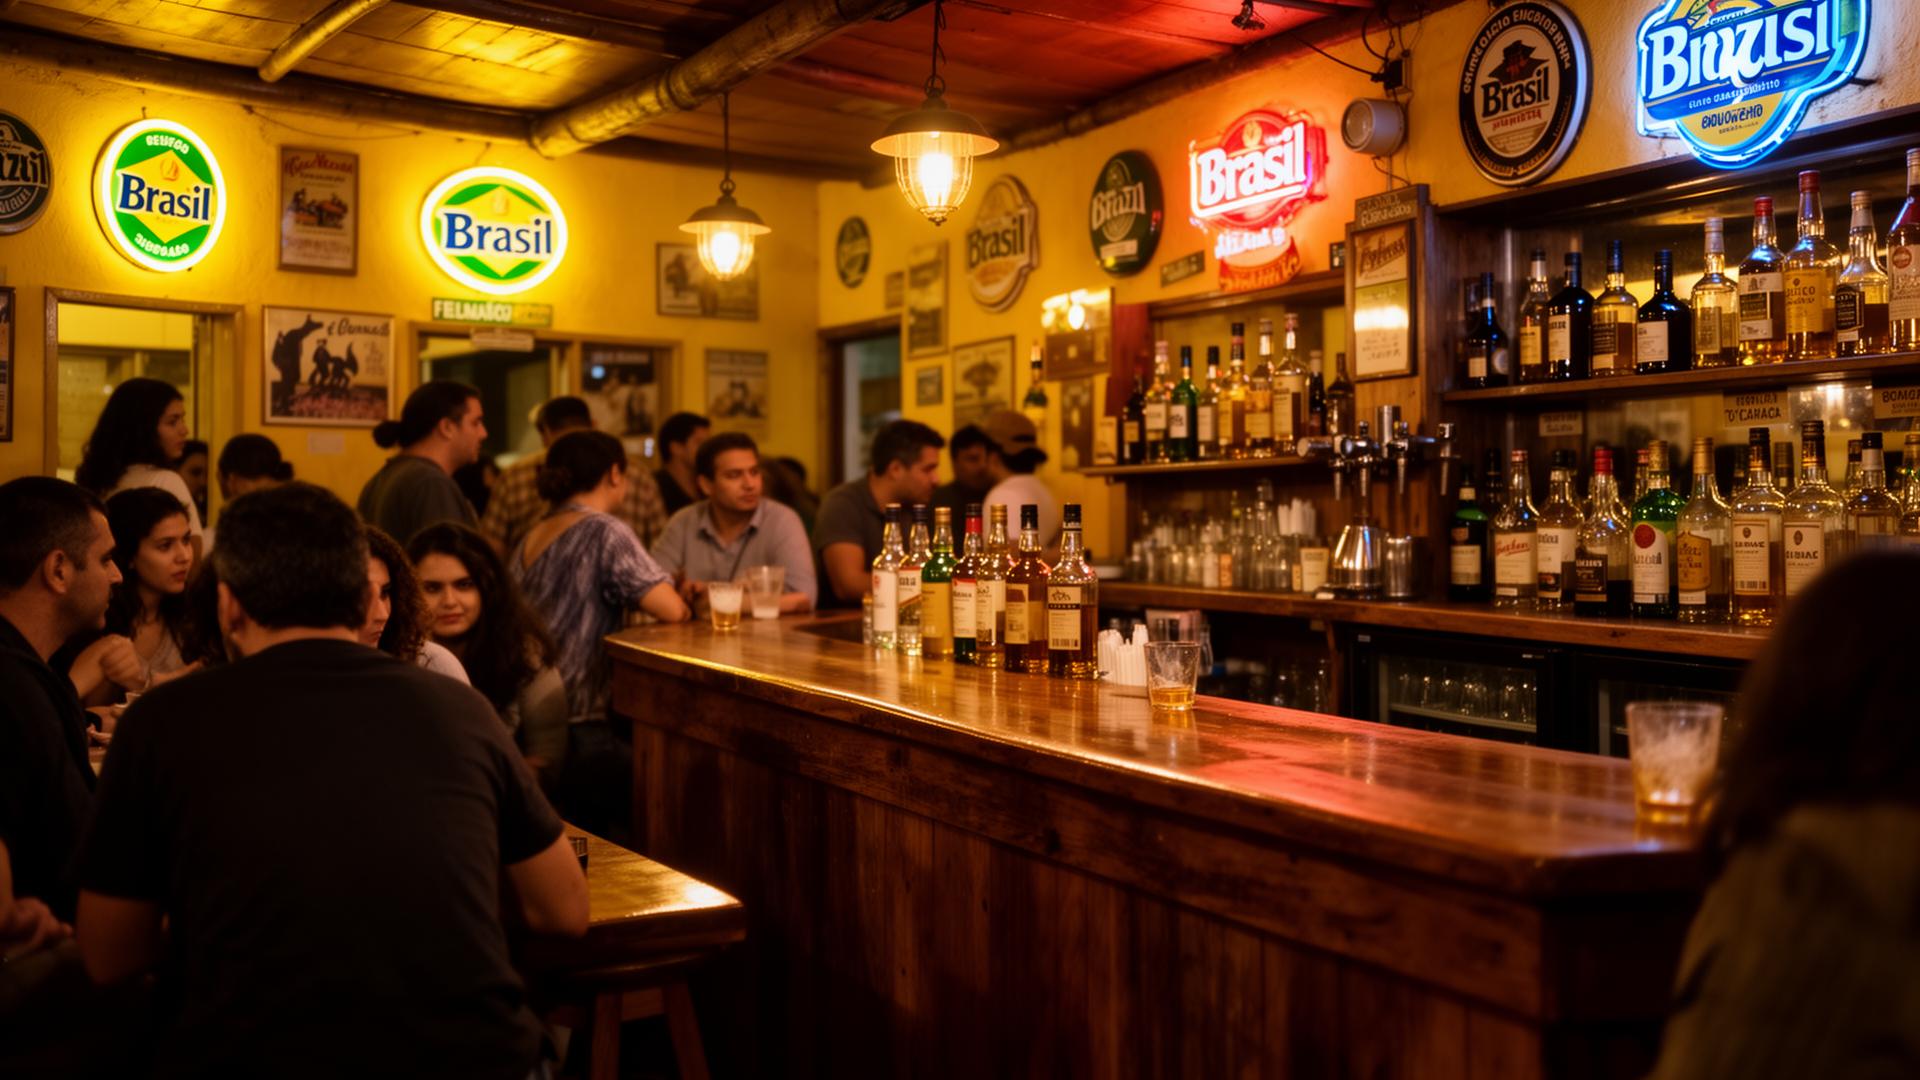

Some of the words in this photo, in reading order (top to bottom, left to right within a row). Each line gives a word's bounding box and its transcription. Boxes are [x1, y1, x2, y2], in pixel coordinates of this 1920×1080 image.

[1480, 66, 1550, 118] Brasil
[1198, 121, 1307, 206] Brasil
[119, 173, 210, 221] Brasil
[444, 213, 551, 254] Brasil
[967, 213, 1025, 269] Brasil
